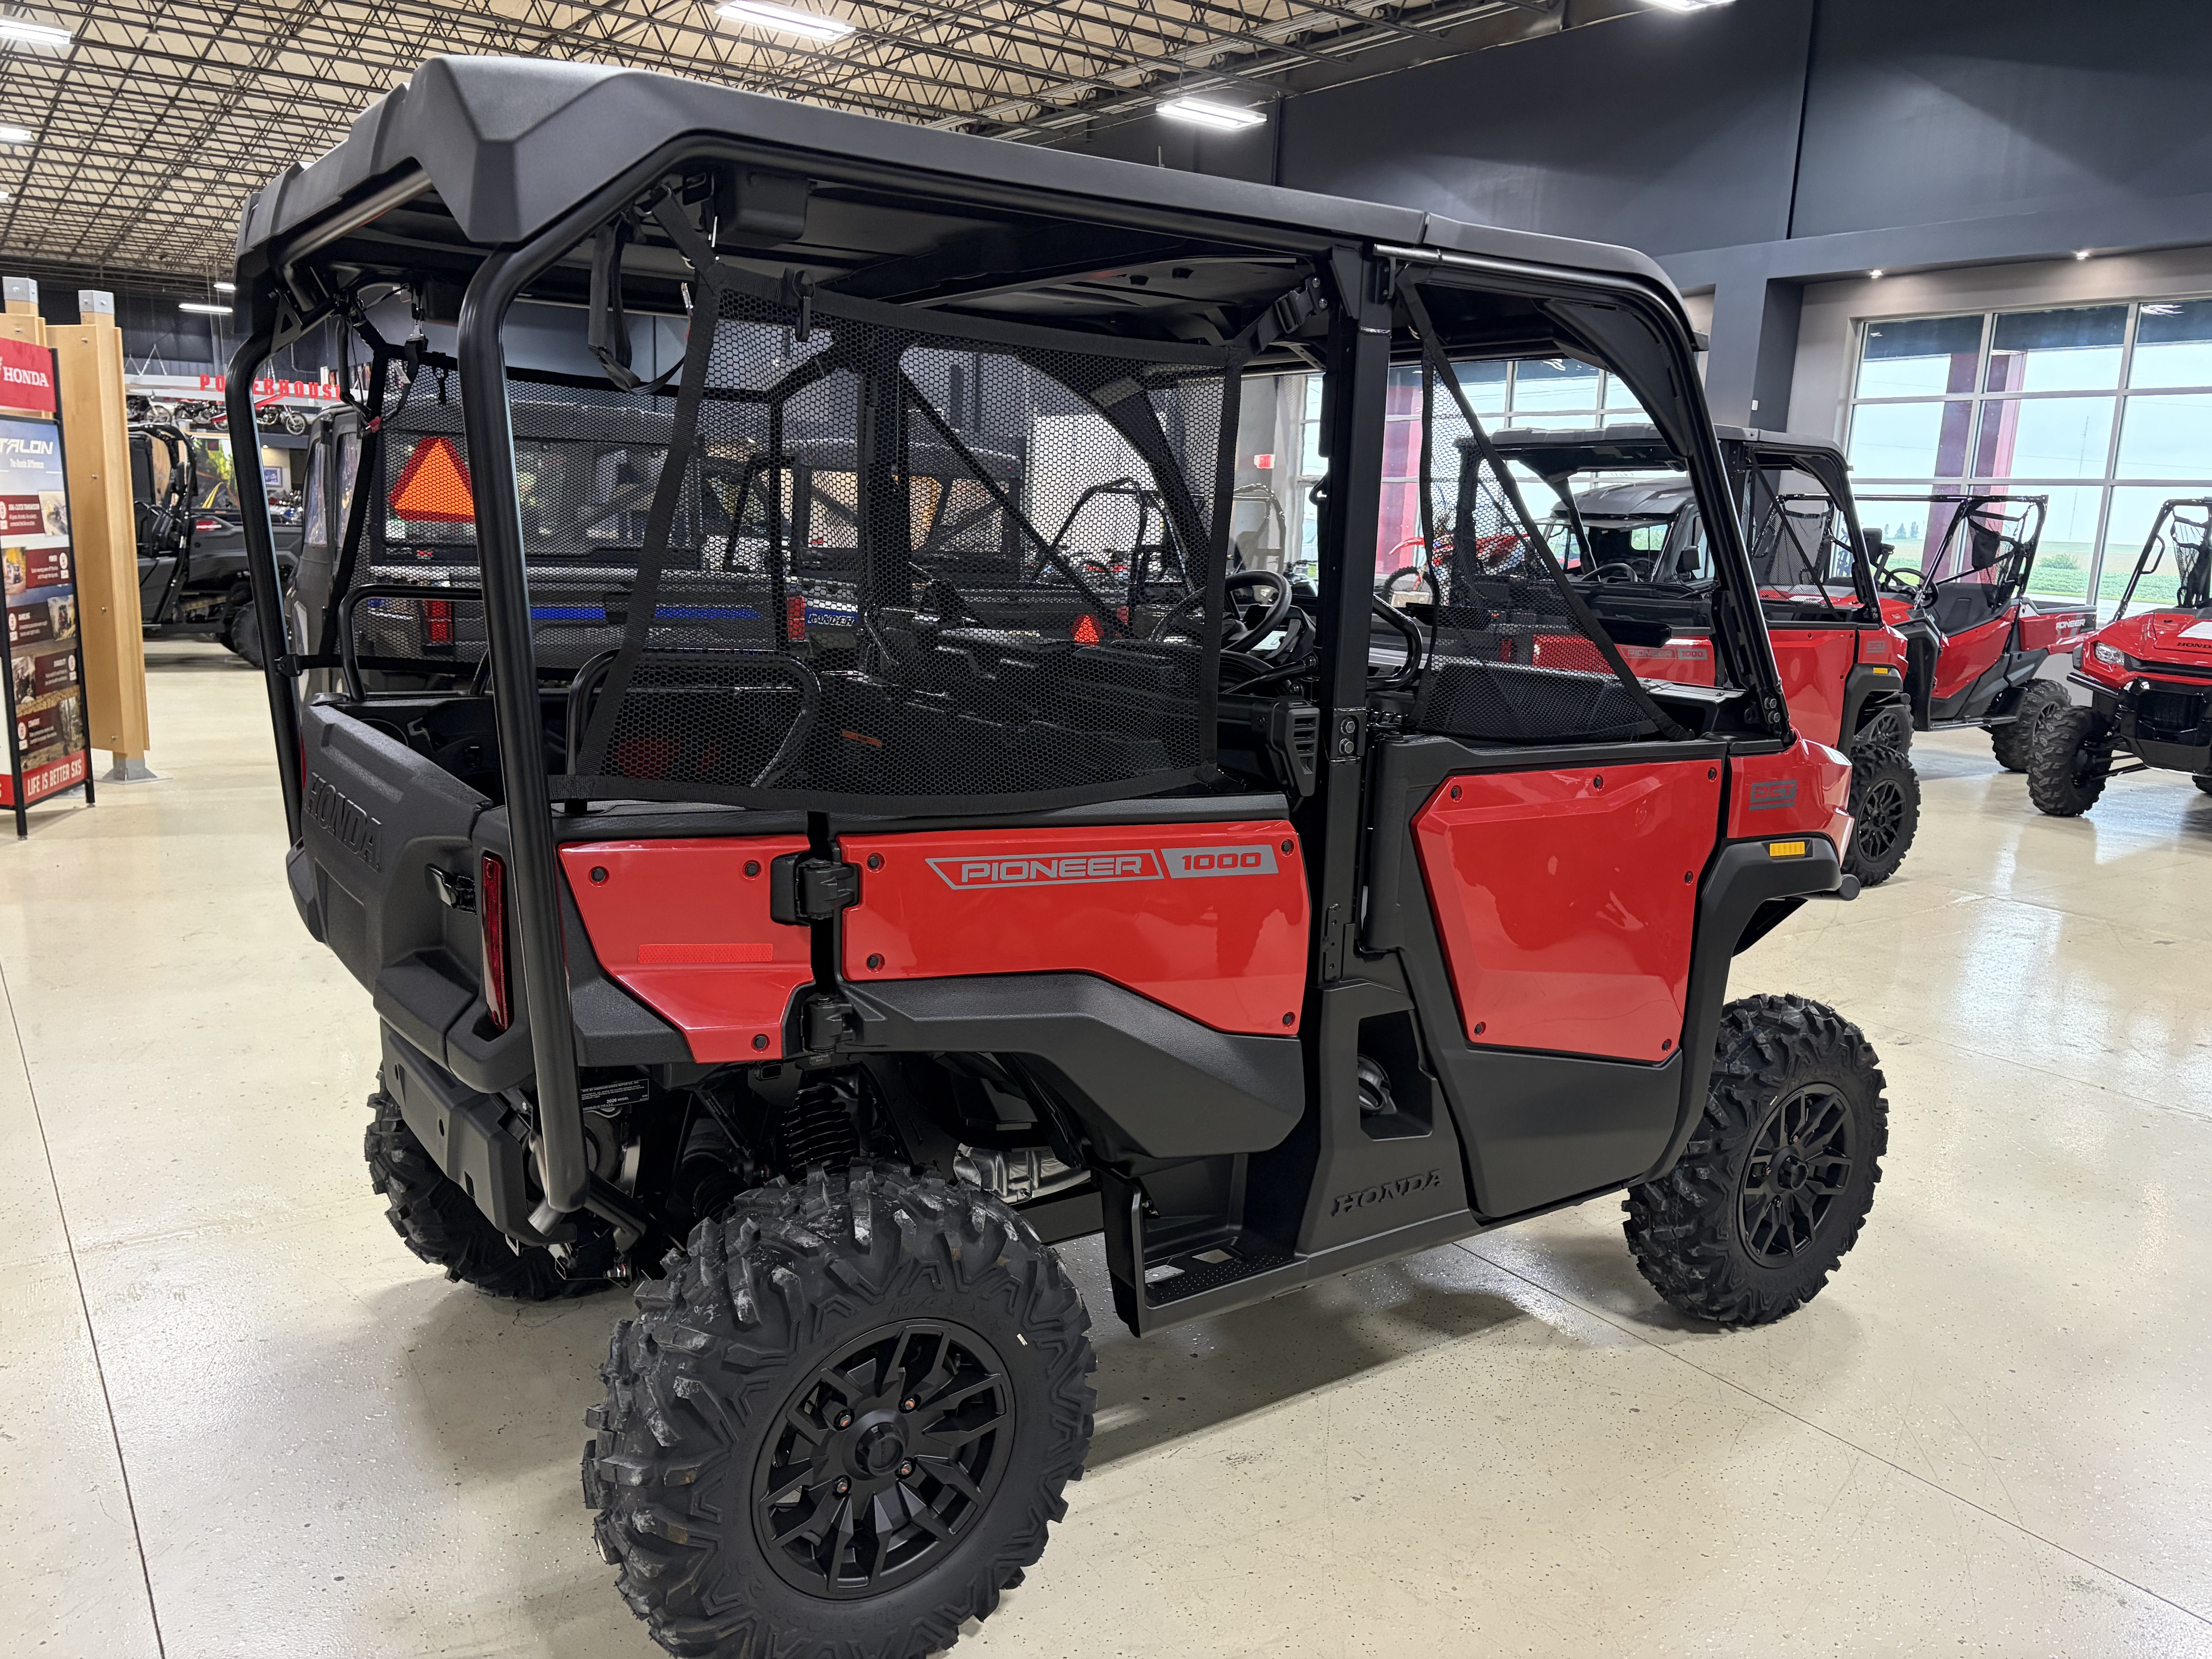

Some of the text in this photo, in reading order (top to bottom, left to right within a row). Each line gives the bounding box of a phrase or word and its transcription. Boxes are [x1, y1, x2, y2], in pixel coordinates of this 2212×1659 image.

[3, 366, 50, 387] HONDA
[200, 374, 340, 401] POERHOUS
[807, 614, 855, 627] RANGER
[27, 759, 82, 796] LIFE IS BETTER SXS
[1754, 784, 1794, 799] DCT
[304, 772, 381, 873] HONDA
[962, 852, 1261, 883] PIONEER 1000
[1331, 1169, 1441, 1217] HONDA
